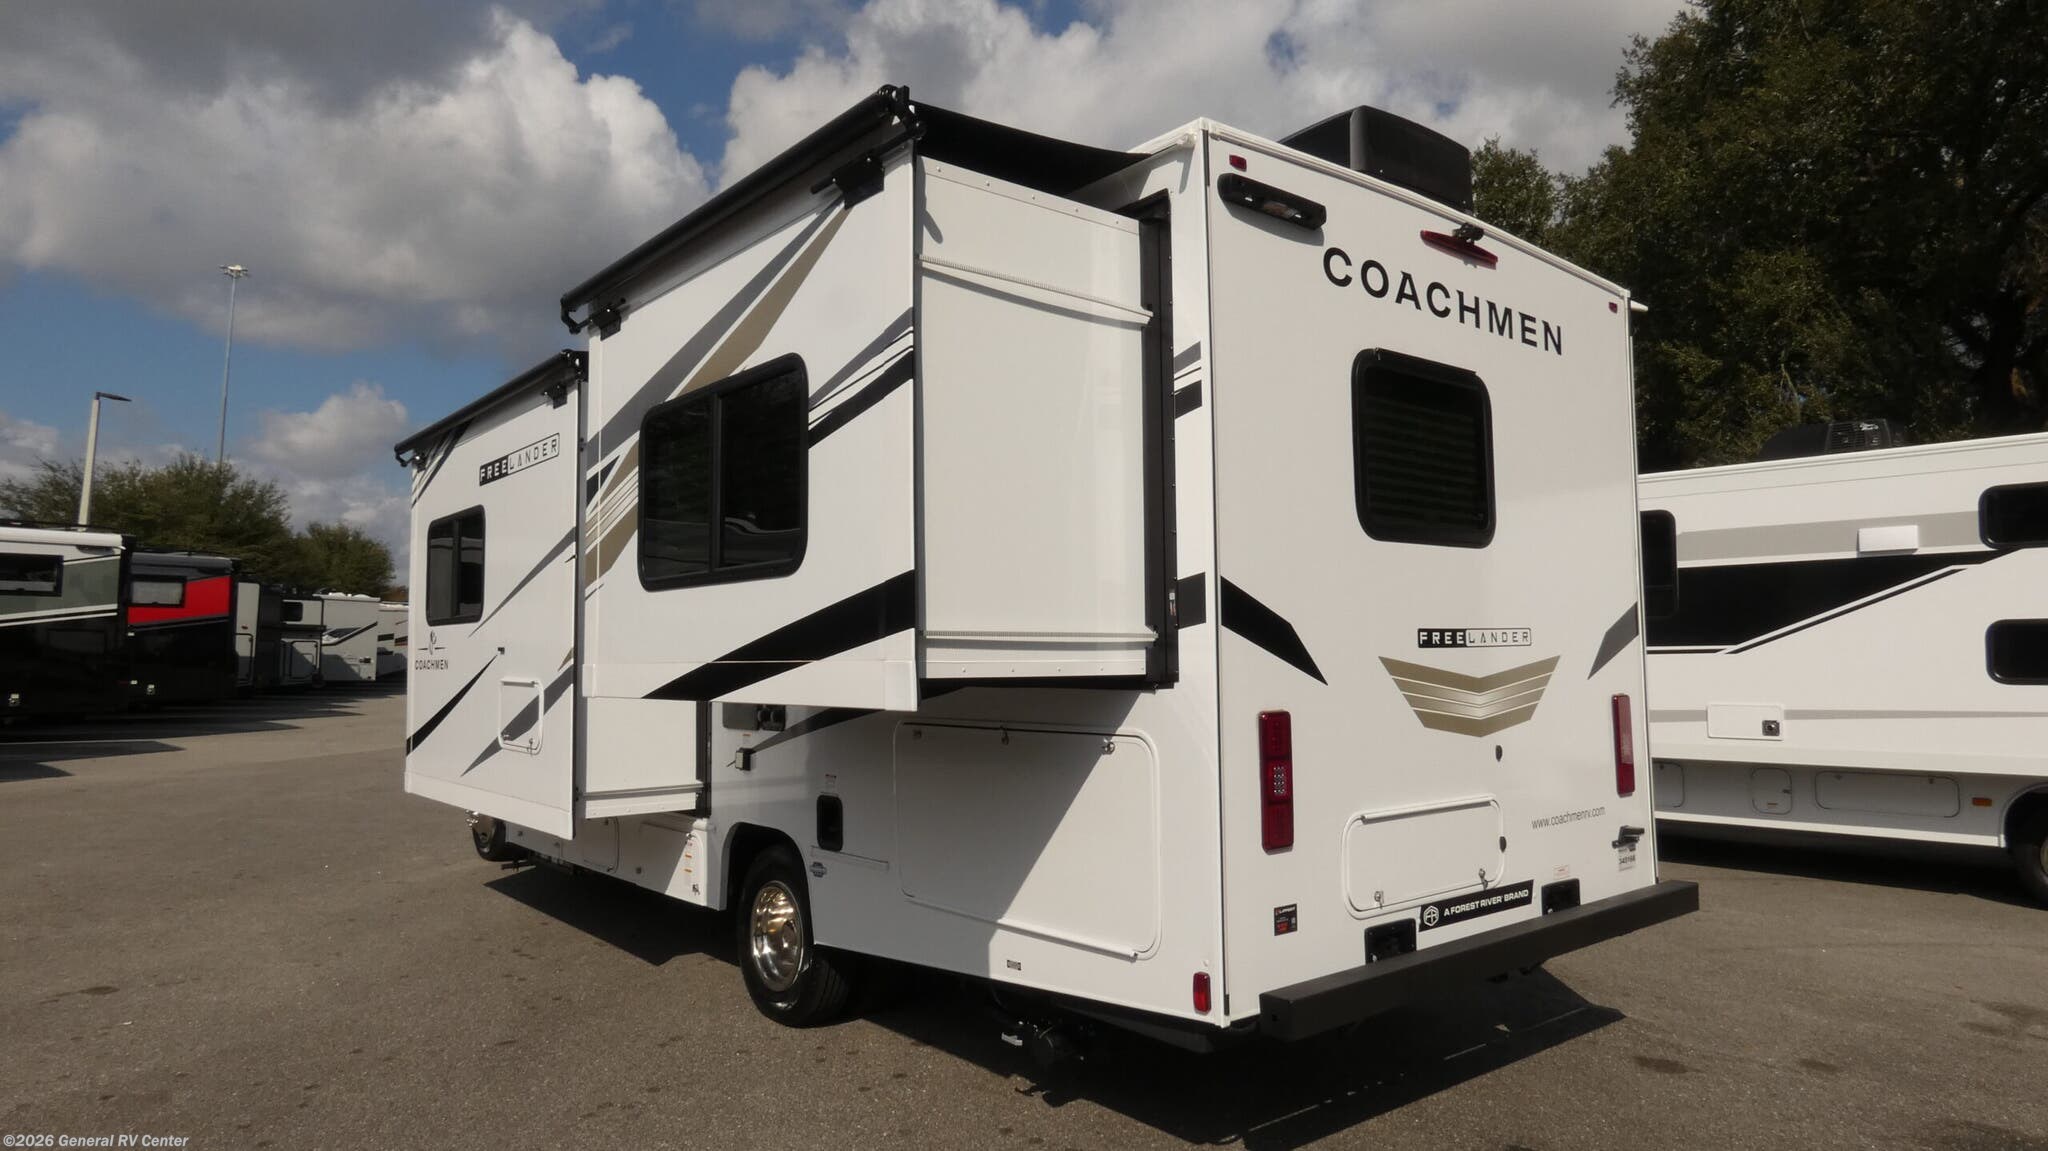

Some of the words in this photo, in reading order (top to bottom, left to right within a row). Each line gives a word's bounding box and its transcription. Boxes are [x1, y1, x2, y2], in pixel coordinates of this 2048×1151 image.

[1323, 247, 1562, 356] COACHMEN
[480, 437, 558, 482] FREELANDER
[1419, 630, 1529, 645] FREELANDER
[415, 659, 449, 670] COACHMEN
[1531, 806, 1605, 829] www.coachmenrv.com
[1443, 908, 1450, 917] A
[1450, 901, 1480, 914] FOREST
[1480, 896, 1502, 907] RIVER
[1503, 889, 1529, 902] BRAND
